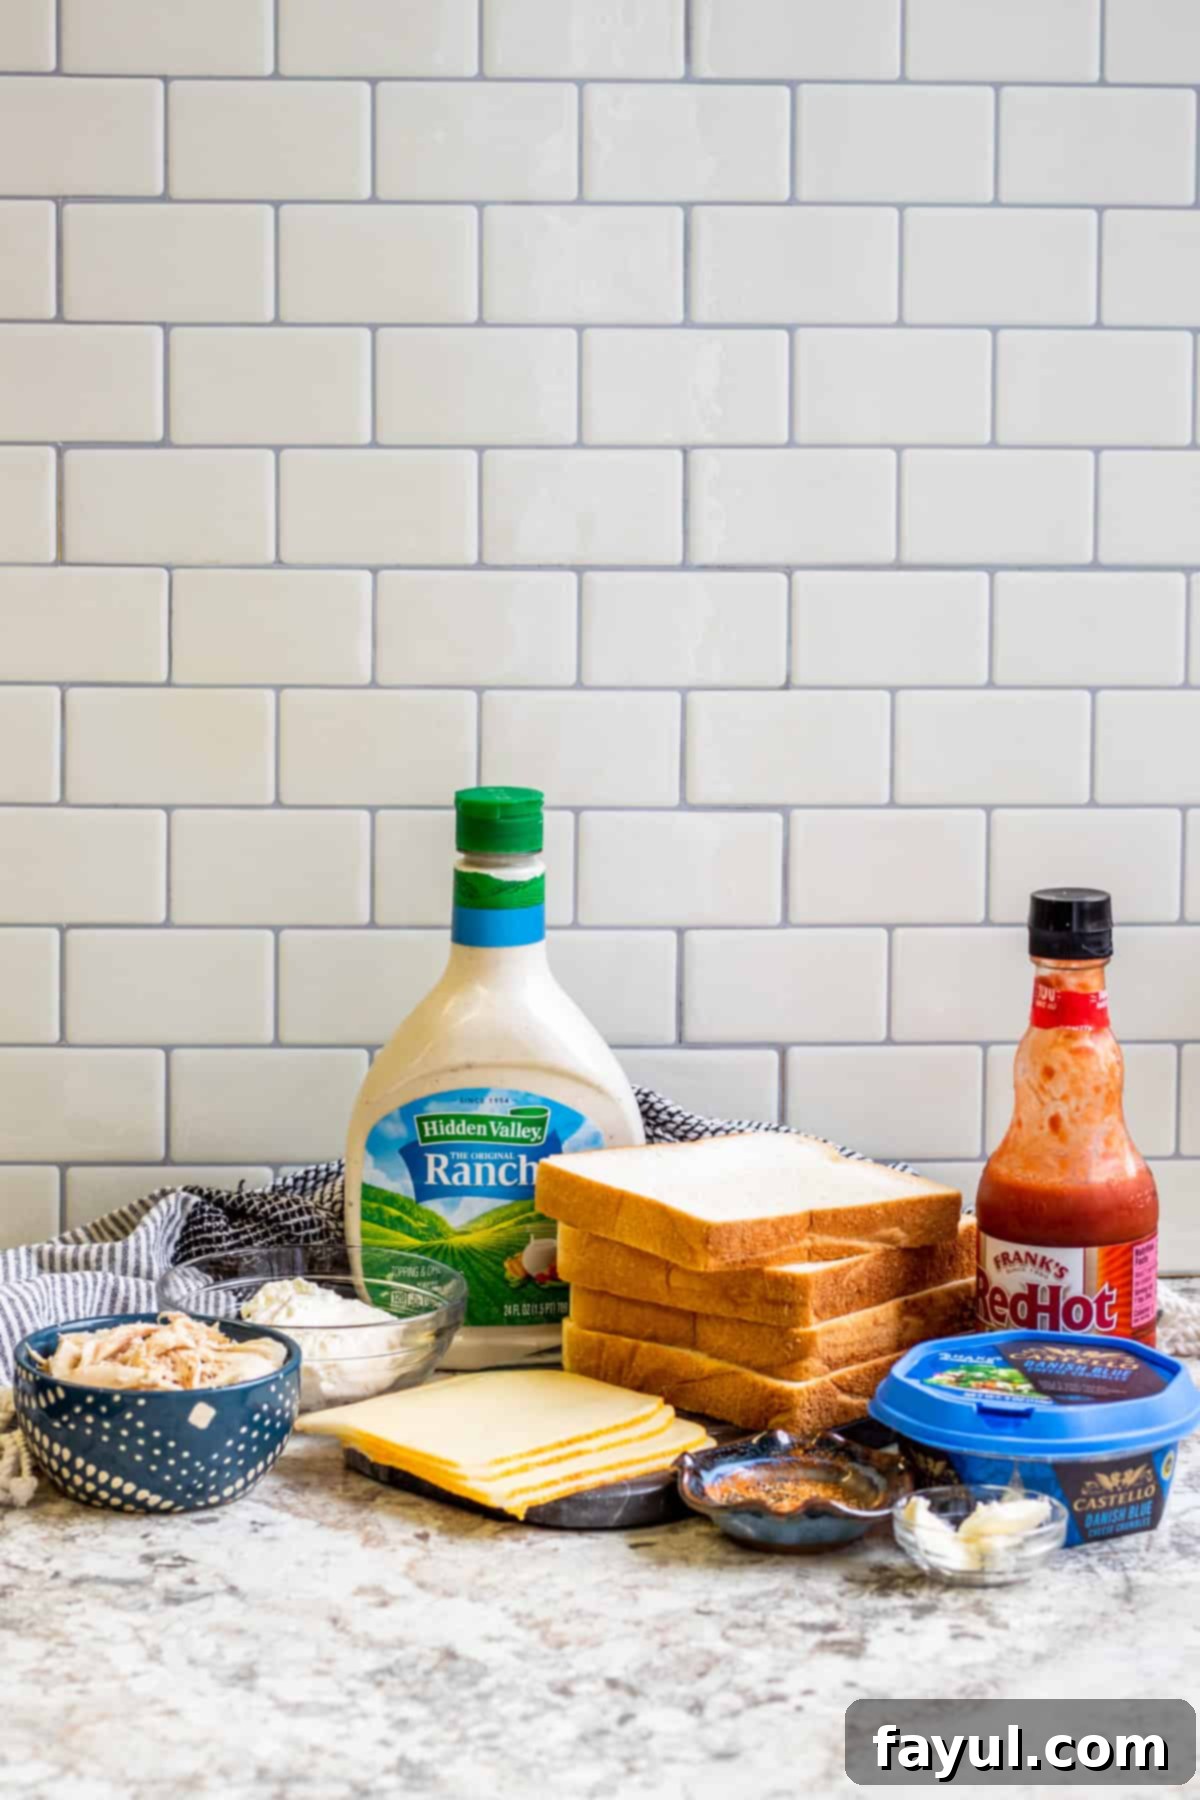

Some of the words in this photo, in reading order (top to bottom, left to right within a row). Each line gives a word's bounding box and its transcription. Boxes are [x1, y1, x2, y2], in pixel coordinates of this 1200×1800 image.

[422, 1118, 487, 1138] Hidden
[424, 1152, 537, 1187] Ranch
[449, 1151, 468, 1160] THE
[470, 1151, 515, 1160] ORIGINAL
[993, 1249, 1069, 1280] FRANK'S
[976, 1264, 1118, 1333] RedHot
[1073, 1483, 1156, 1512] CASTELLO
[1084, 1507, 1127, 1529] DANISH
[1127, 1499, 1153, 1520] BLUE
